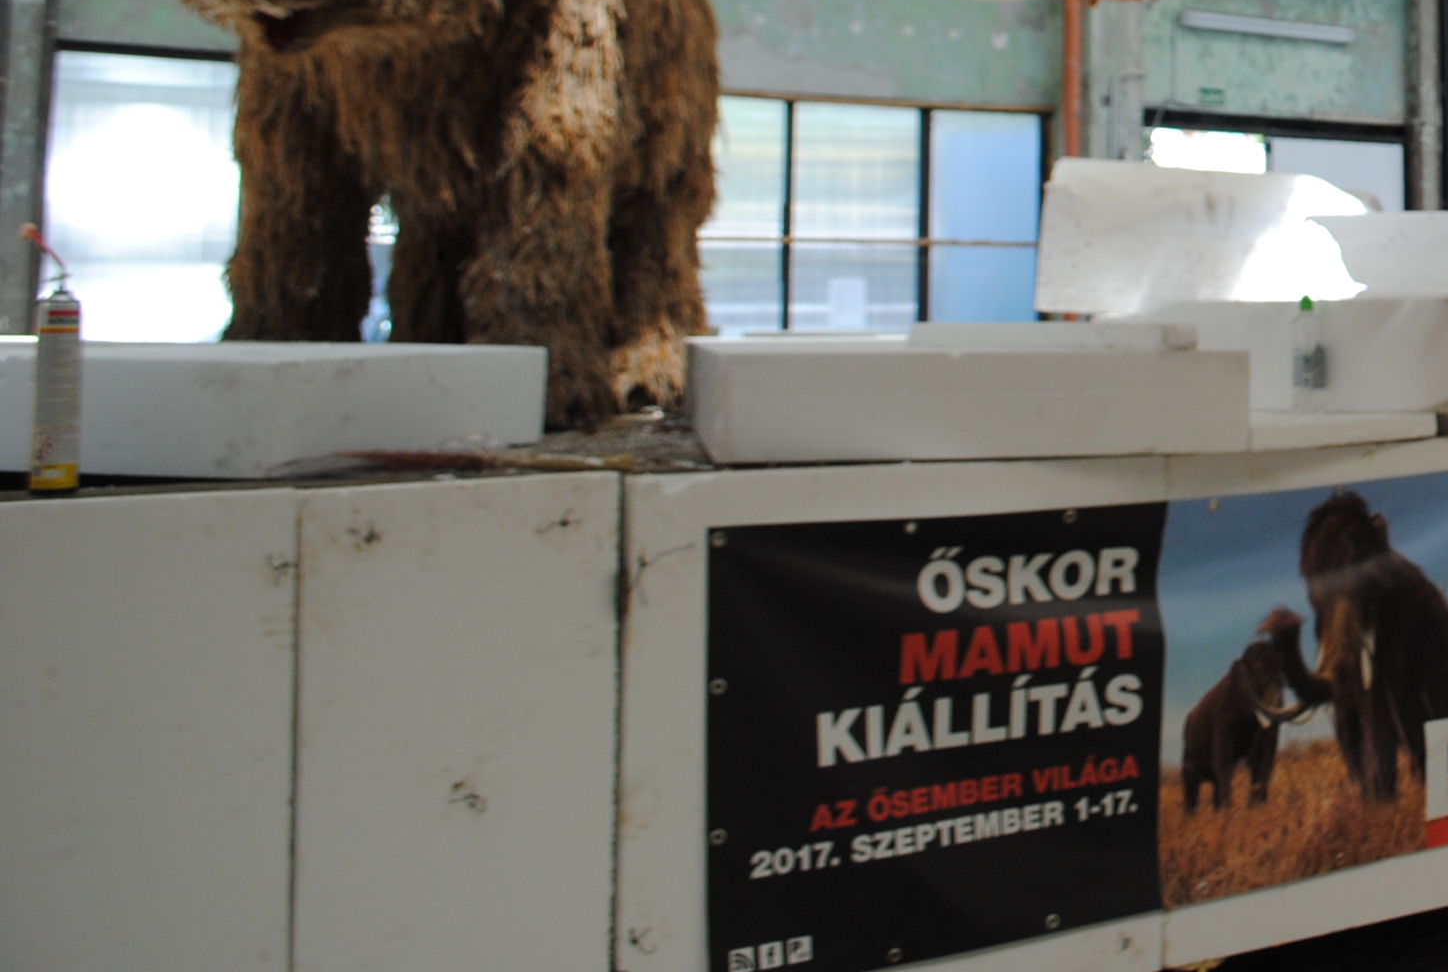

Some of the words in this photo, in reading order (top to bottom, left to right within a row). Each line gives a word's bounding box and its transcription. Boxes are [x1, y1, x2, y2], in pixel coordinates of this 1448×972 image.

[917, 546, 1140, 614] ŐSKOR
[899, 609, 1139, 684] MAMUT
[816, 666, 1143, 767] KIÁLLÍTÁS
[810, 799, 857, 830] AZ
[867, 773, 1023, 822] ŐSEMBER
[1031, 755, 1139, 793] VILÁGA
[750, 841, 842, 879] 2017.
[850, 801, 1064, 863] SZEPTEMBER
[1074, 789, 1138, 822] 1-17.
